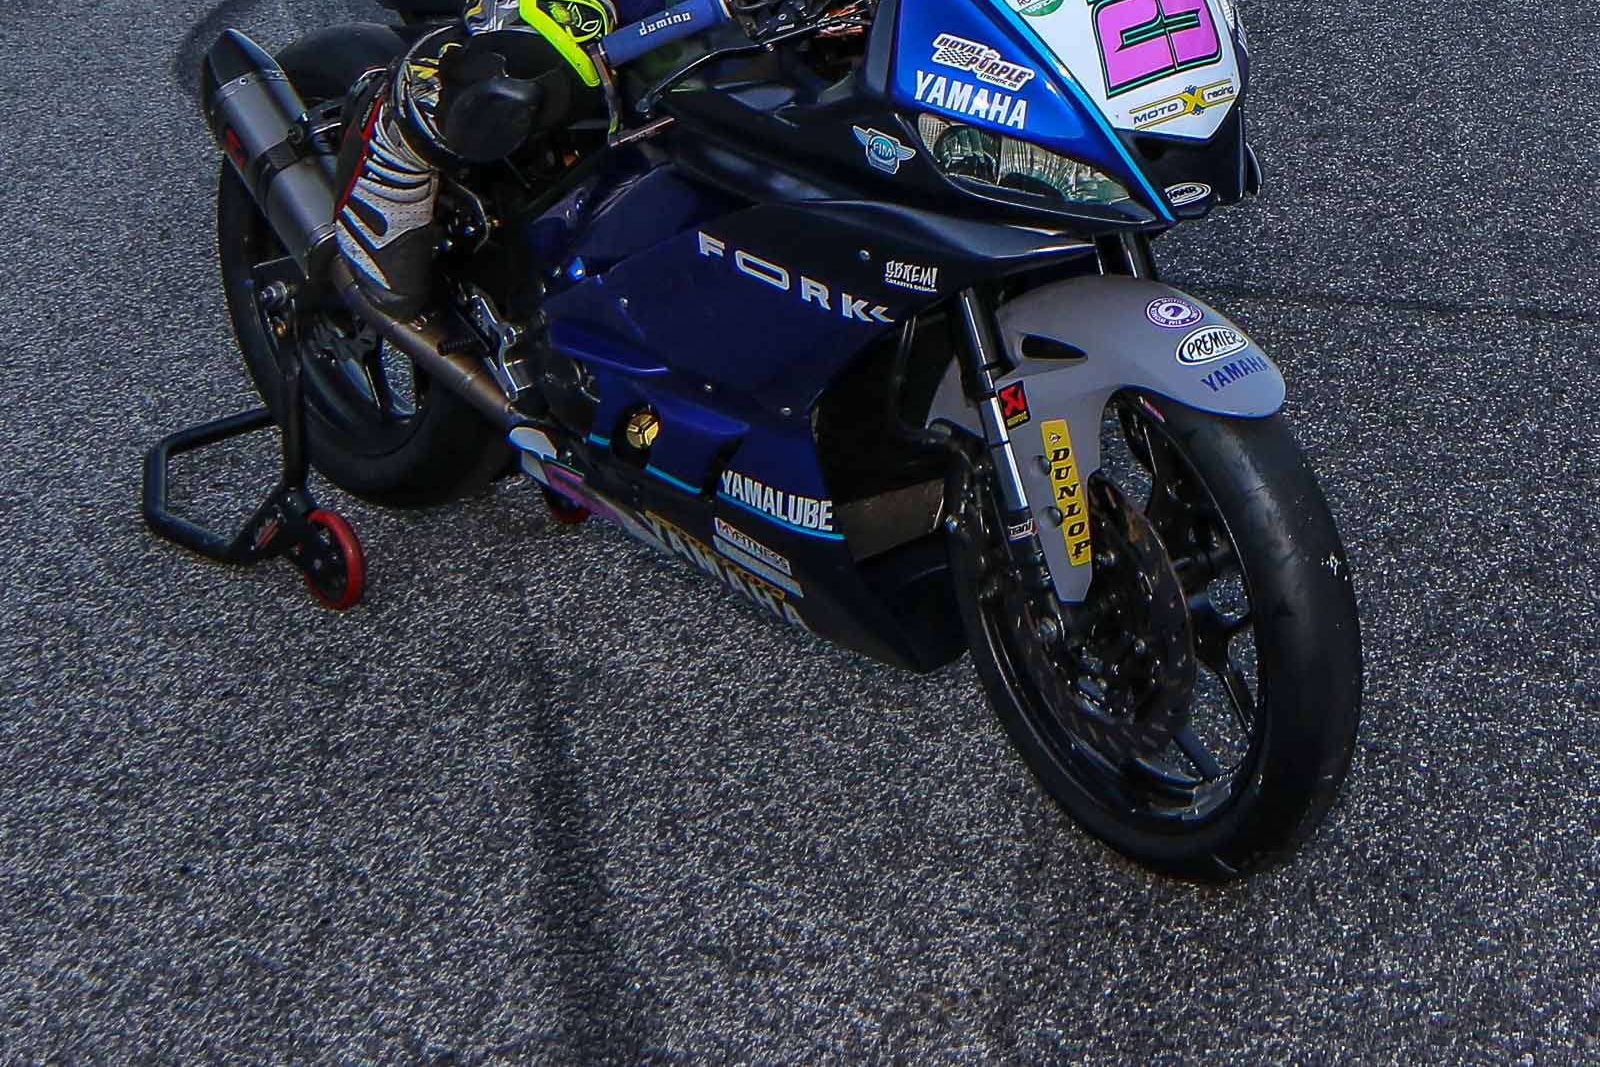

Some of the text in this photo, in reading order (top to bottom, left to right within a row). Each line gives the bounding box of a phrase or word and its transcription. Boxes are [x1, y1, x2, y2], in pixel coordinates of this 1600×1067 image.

[936, 36, 985, 57] ROYAL
[965, 55, 1033, 84] PURPLE
[914, 69, 1028, 130] YAMAHA
[1133, 102, 1178, 125] MOTO
[1207, 86, 1235, 100] racing
[873, 141, 893, 157] FIM
[1187, 330, 1243, 359] PREMIER
[1201, 356, 1271, 393] YAMAHA
[721, 469, 834, 532] YAMALUBE
[1050, 447, 1092, 560] DUNLOP
